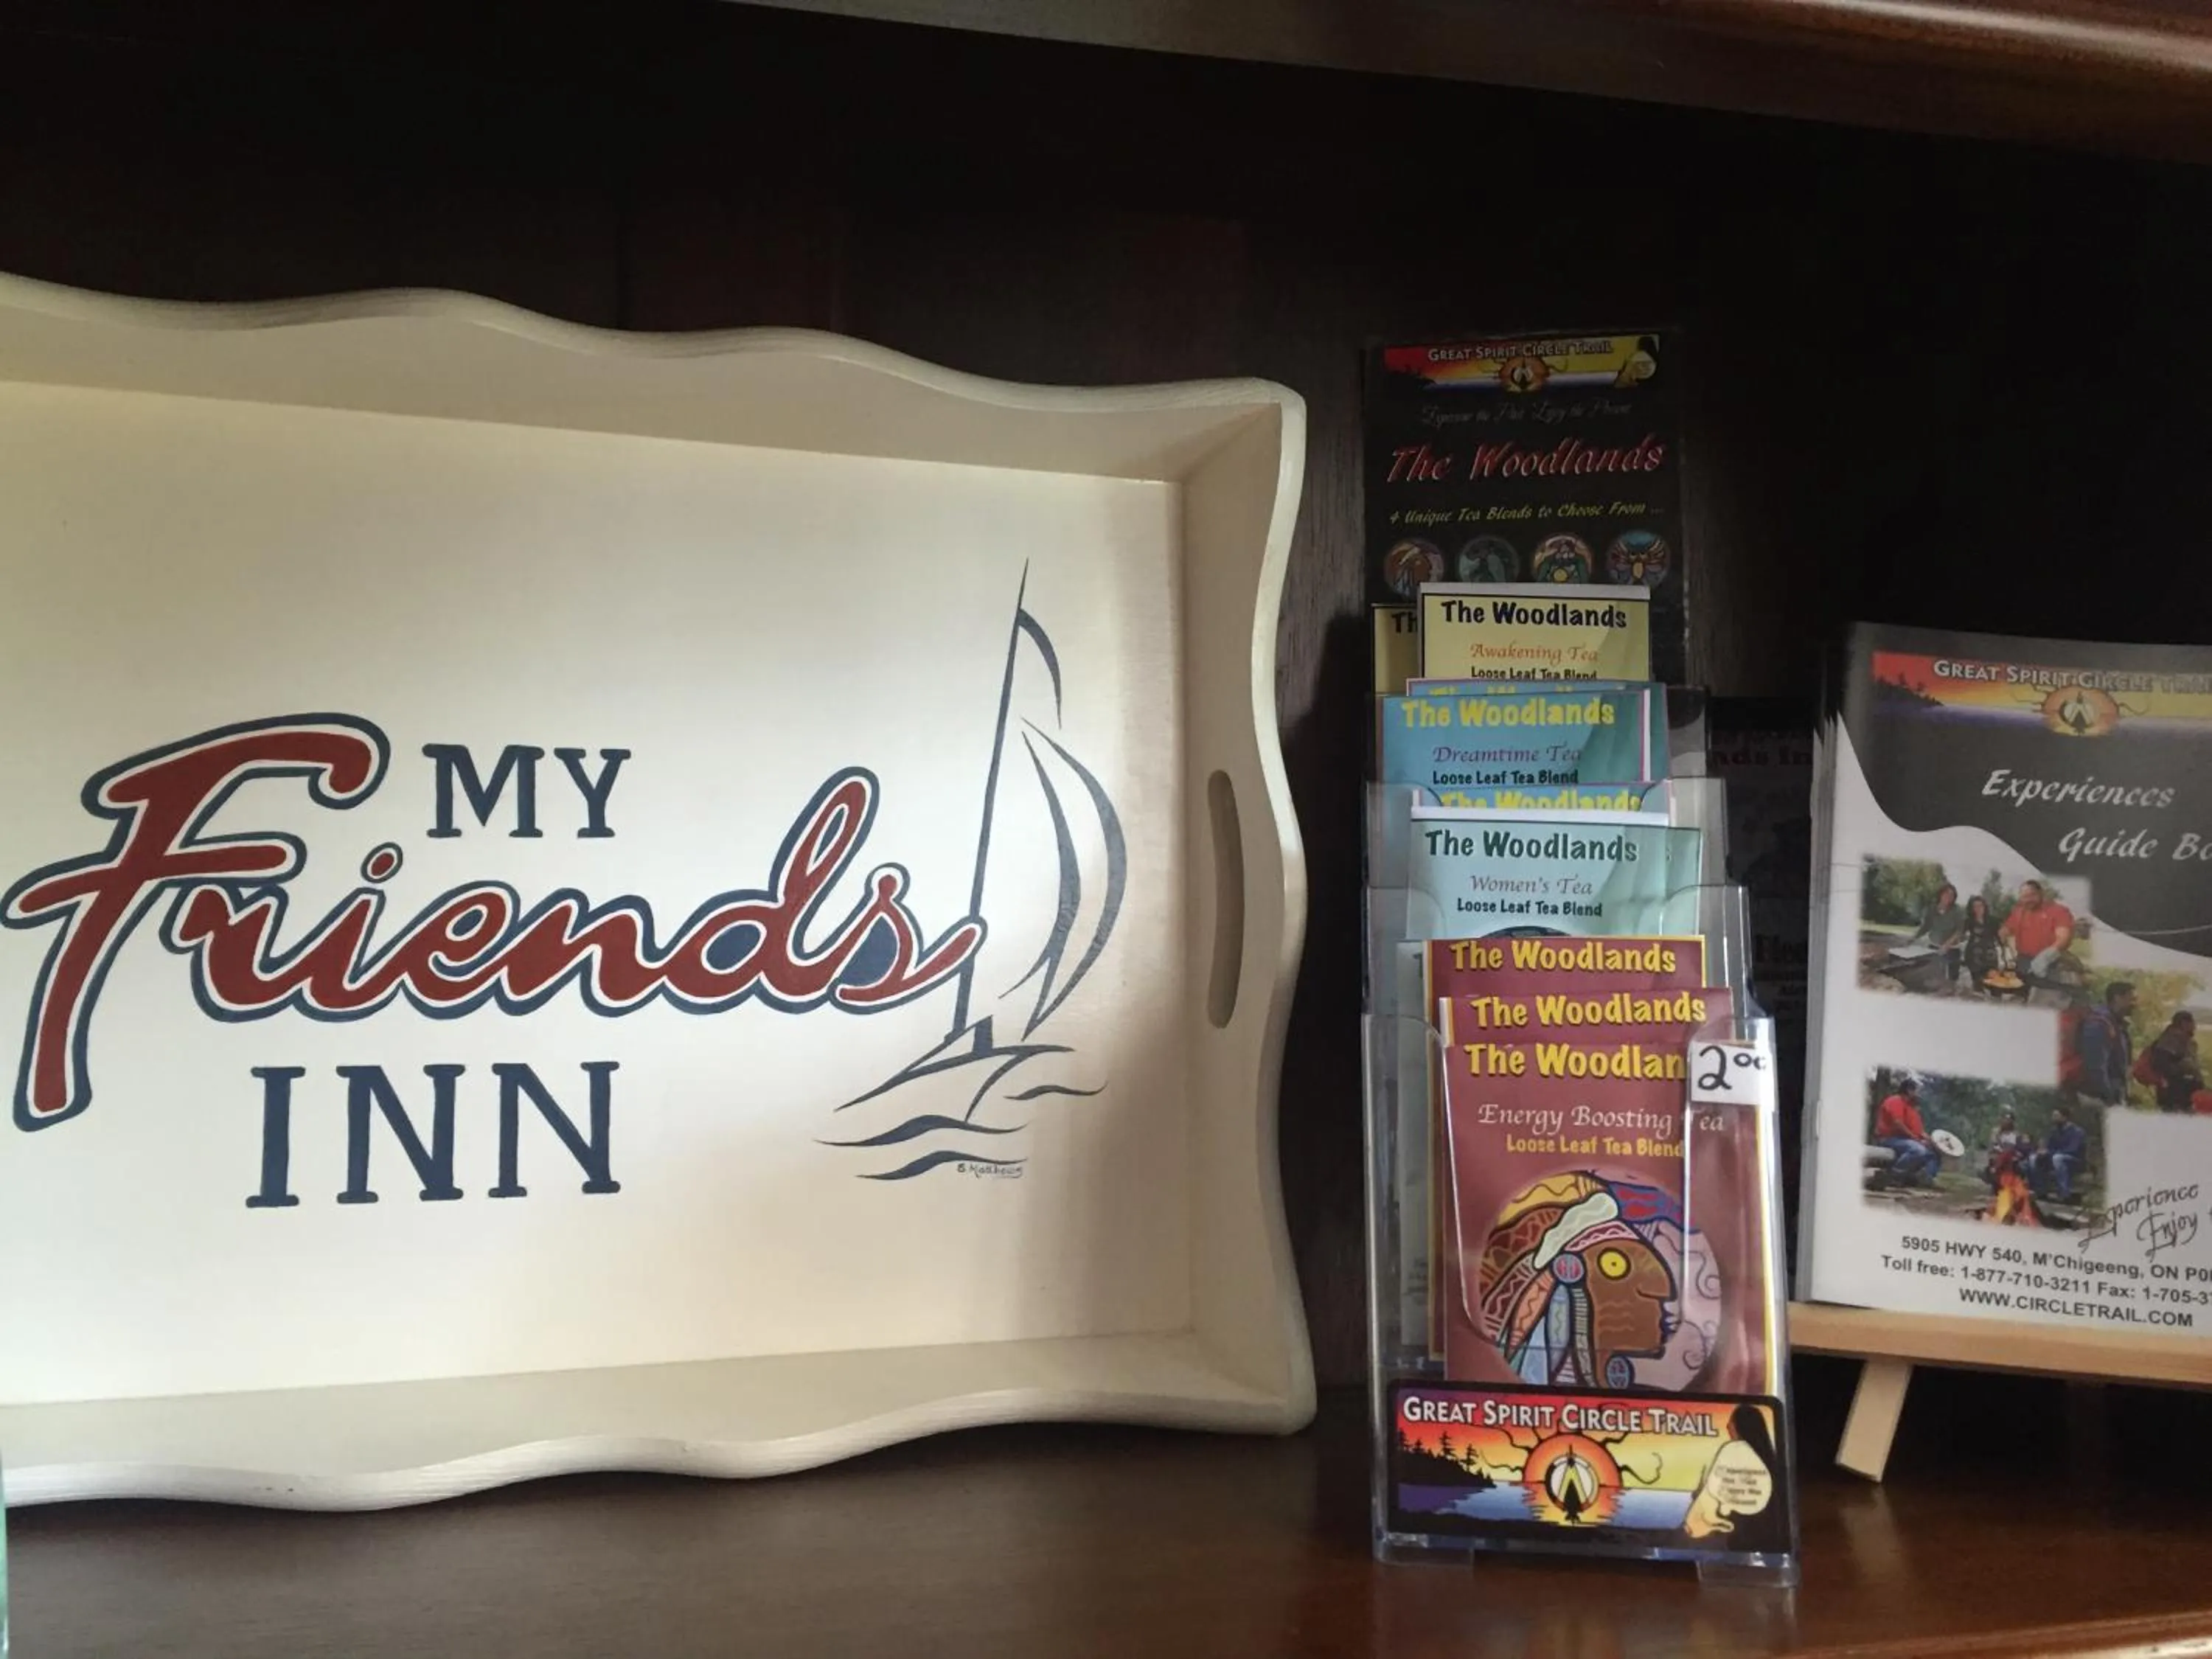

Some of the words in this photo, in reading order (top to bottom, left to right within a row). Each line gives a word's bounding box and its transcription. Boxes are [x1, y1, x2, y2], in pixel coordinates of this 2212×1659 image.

[1427, 348, 1472, 361] GREAT
[1475, 345, 1516, 359] SPIRIT
[1386, 445, 1452, 483] The
[1469, 433, 1666, 481] Woodlands
[1404, 509, 1452, 527] Unique
[1457, 507, 1481, 522] Tea
[1486, 505, 1532, 521] Blends
[1537, 505, 1551, 518] to
[1557, 502, 1604, 518] Choose
[1608, 501, 1646, 515] From
[1391, 611, 1418, 634] Th
[1440, 599, 1485, 624] The
[1492, 601, 1627, 629] Woodlands
[1469, 642, 1562, 666] Awakening
[1566, 641, 1599, 661] Tea
[1470, 666, 1506, 679] Loose
[1510, 667, 1537, 680] Leaf
[1540, 668, 1560, 680] Tea
[1563, 668, 1598, 680] Blend
[1933, 659, 2000, 682] GREAT
[2006, 665, 2073, 688] SPIRIT
[1402, 698, 1452, 729] The
[1458, 695, 1615, 728] Woodlands
[1432, 745, 1540, 764] Dreamtime
[1545, 740, 1582, 762] Tea
[422, 742, 632, 839] MY
[1432, 771, 1472, 785] Loose
[1475, 770, 1506, 785] Leaf
[1511, 770, 1534, 785] Tea
[1538, 769, 1579, 785] Blend
[1981, 768, 2177, 810] Experiences
[1425, 830, 1475, 858] The
[1482, 830, 1638, 863] Woodlands
[2058, 827, 2160, 864] Guide
[2171, 832, 2212, 861] Bo
[1469, 874, 1550, 894] Women's
[1556, 873, 1593, 895] Tea
[1, 712, 988, 1133] Friends
[1456, 897, 1497, 914] Loose
[1500, 898, 1531, 914] Leaf
[1535, 900, 1559, 916] Tea
[1562, 901, 1603, 918] Blend
[1449, 940, 1503, 971] The
[1510, 940, 1676, 974] Woodlands
[1470, 995, 1529, 1029] The
[1534, 991, 1708, 1026] Woodlands
[1463, 1043, 1526, 1077] The
[1534, 1043, 1686, 1081] Woodlan
[245, 1060, 622, 1209] INN
[1478, 1103, 1565, 1136] Energy
[1570, 1105, 1673, 1140] Boosting
[1506, 1135, 1556, 1154] Loose
[1559, 1135, 1598, 1155] Leaf
[1604, 1138, 1632, 1155] Tea
[1636, 1137, 1685, 1158] Blend
[2136, 1209, 2199, 1264] Enjoy
[1901, 1235, 1941, 1253] 5905
[1945, 1240, 1988, 1259] HWY
[2150, 1264, 2179, 1281] ON
[1881, 1254, 1912, 1272] Toll
[1917, 1259, 1955, 1278] free:
[1960, 1265, 2090, 1295] 1-877-710-3211
[2097, 1284, 2136, 1300] Fax:
[2141, 1286, 2212, 1307] 1-705-3
[1958, 1287, 2194, 1328] WWW.CIRCLETRAIL.COM
[1402, 1396, 1478, 1426] GREAT
[1483, 1400, 1556, 1429] SPIRIT
[1562, 1403, 1642, 1433] CIRCLE
[1649, 1408, 1719, 1438] TRAIL
